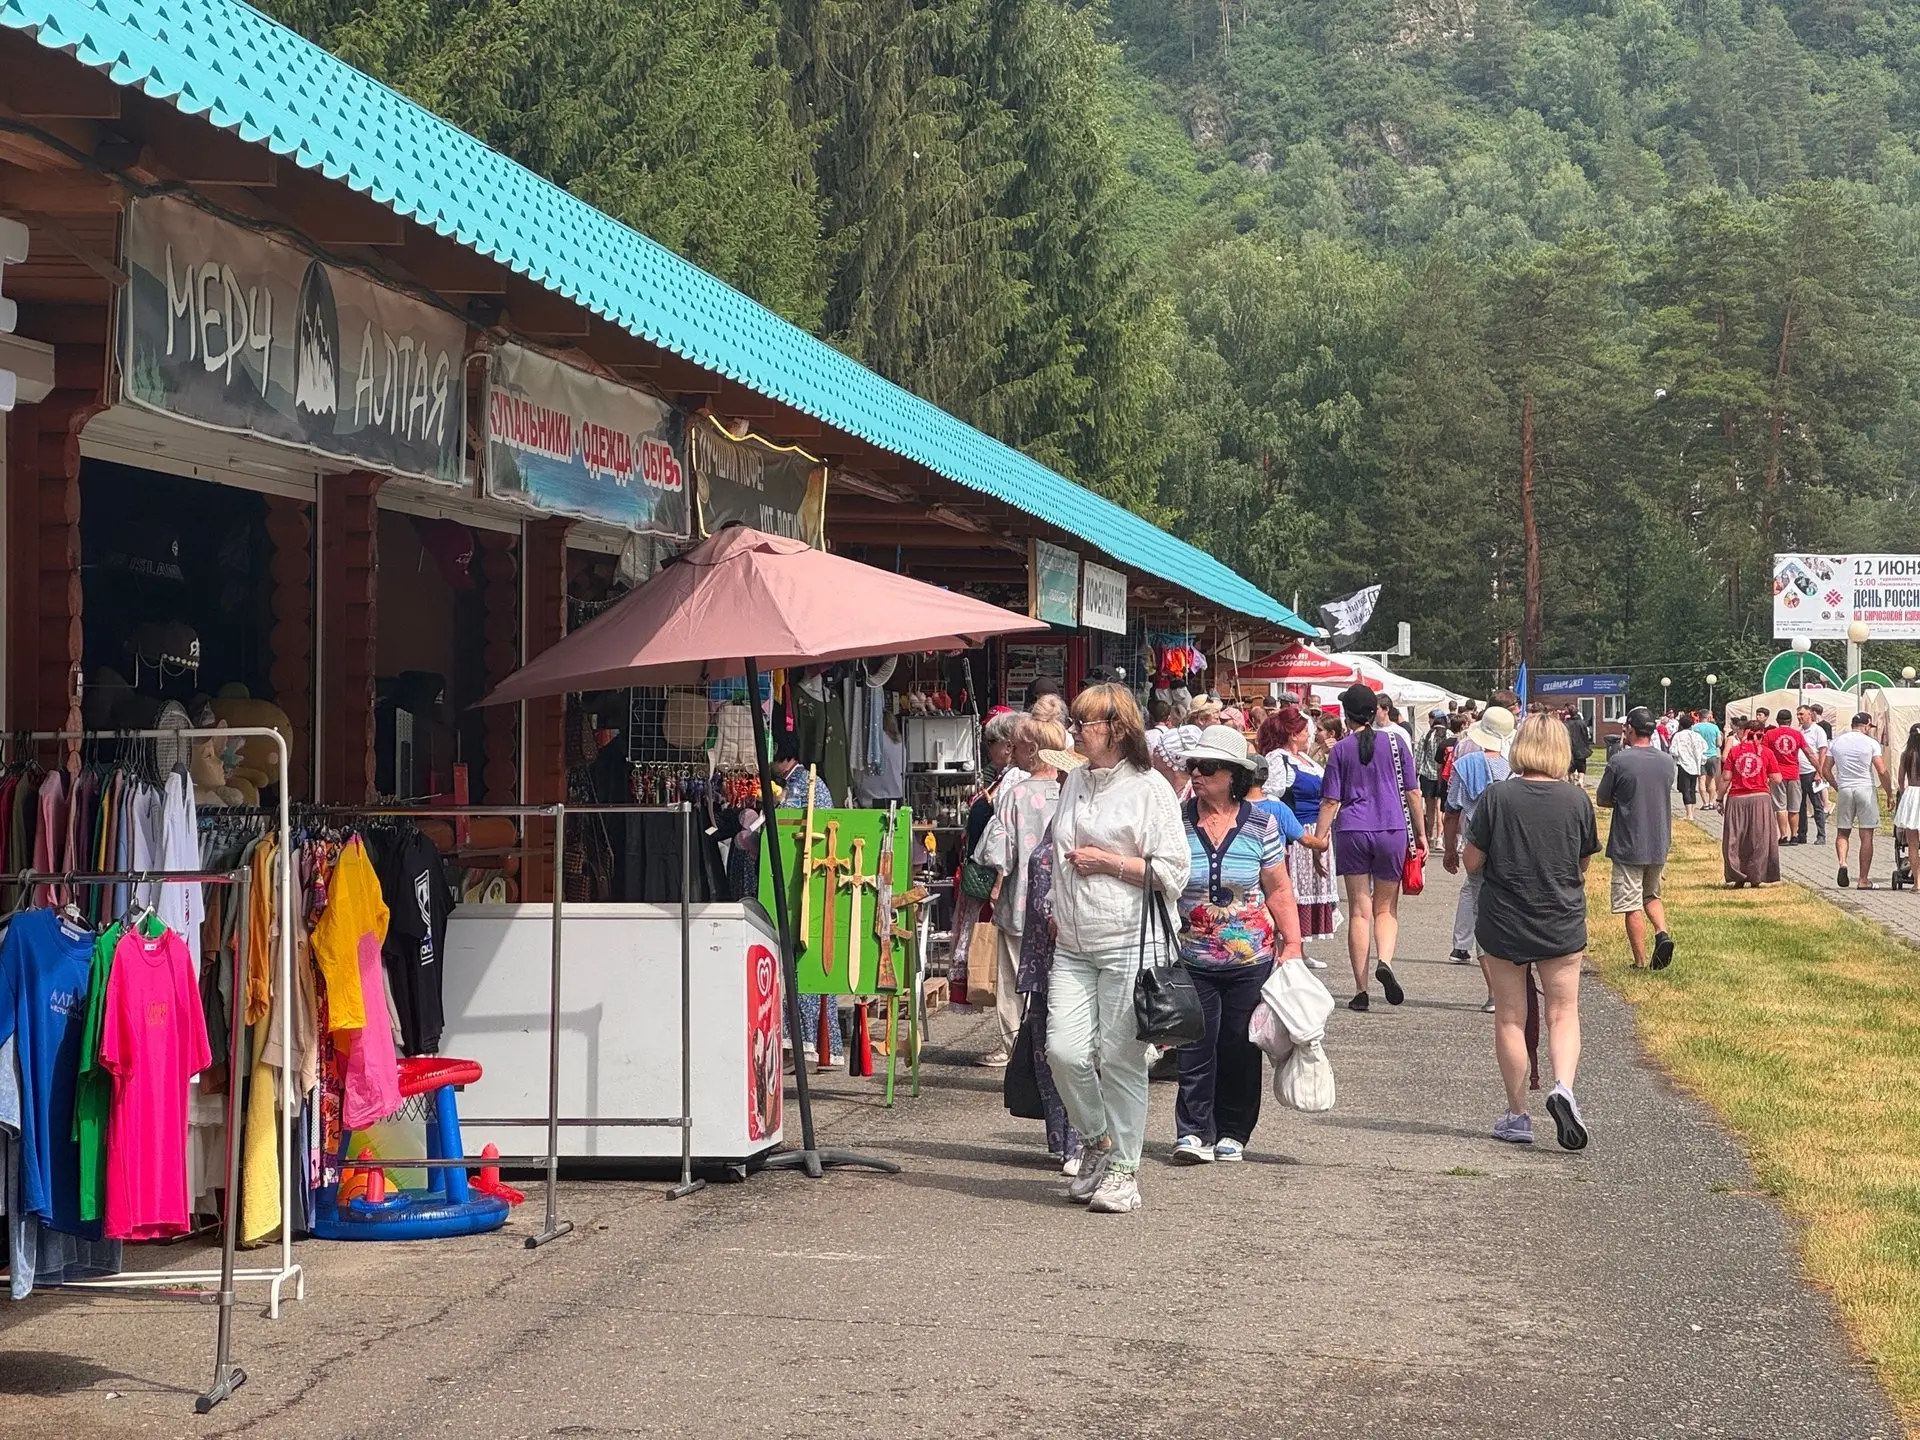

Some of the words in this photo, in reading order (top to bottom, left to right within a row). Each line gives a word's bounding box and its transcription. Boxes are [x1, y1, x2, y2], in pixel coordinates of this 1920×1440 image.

[166, 243, 273, 398] МЕРЧ
[353, 320, 451, 447] АЛТАЯ
[582, 421, 633, 478] ОДЕЖДА
[642, 440, 681, 487] ОБУВЬ
[1854, 560, 1872, 575] 12
[1854, 578, 1876, 586] 15:00
[1854, 589, 1882, 609] ДЕНЬ
